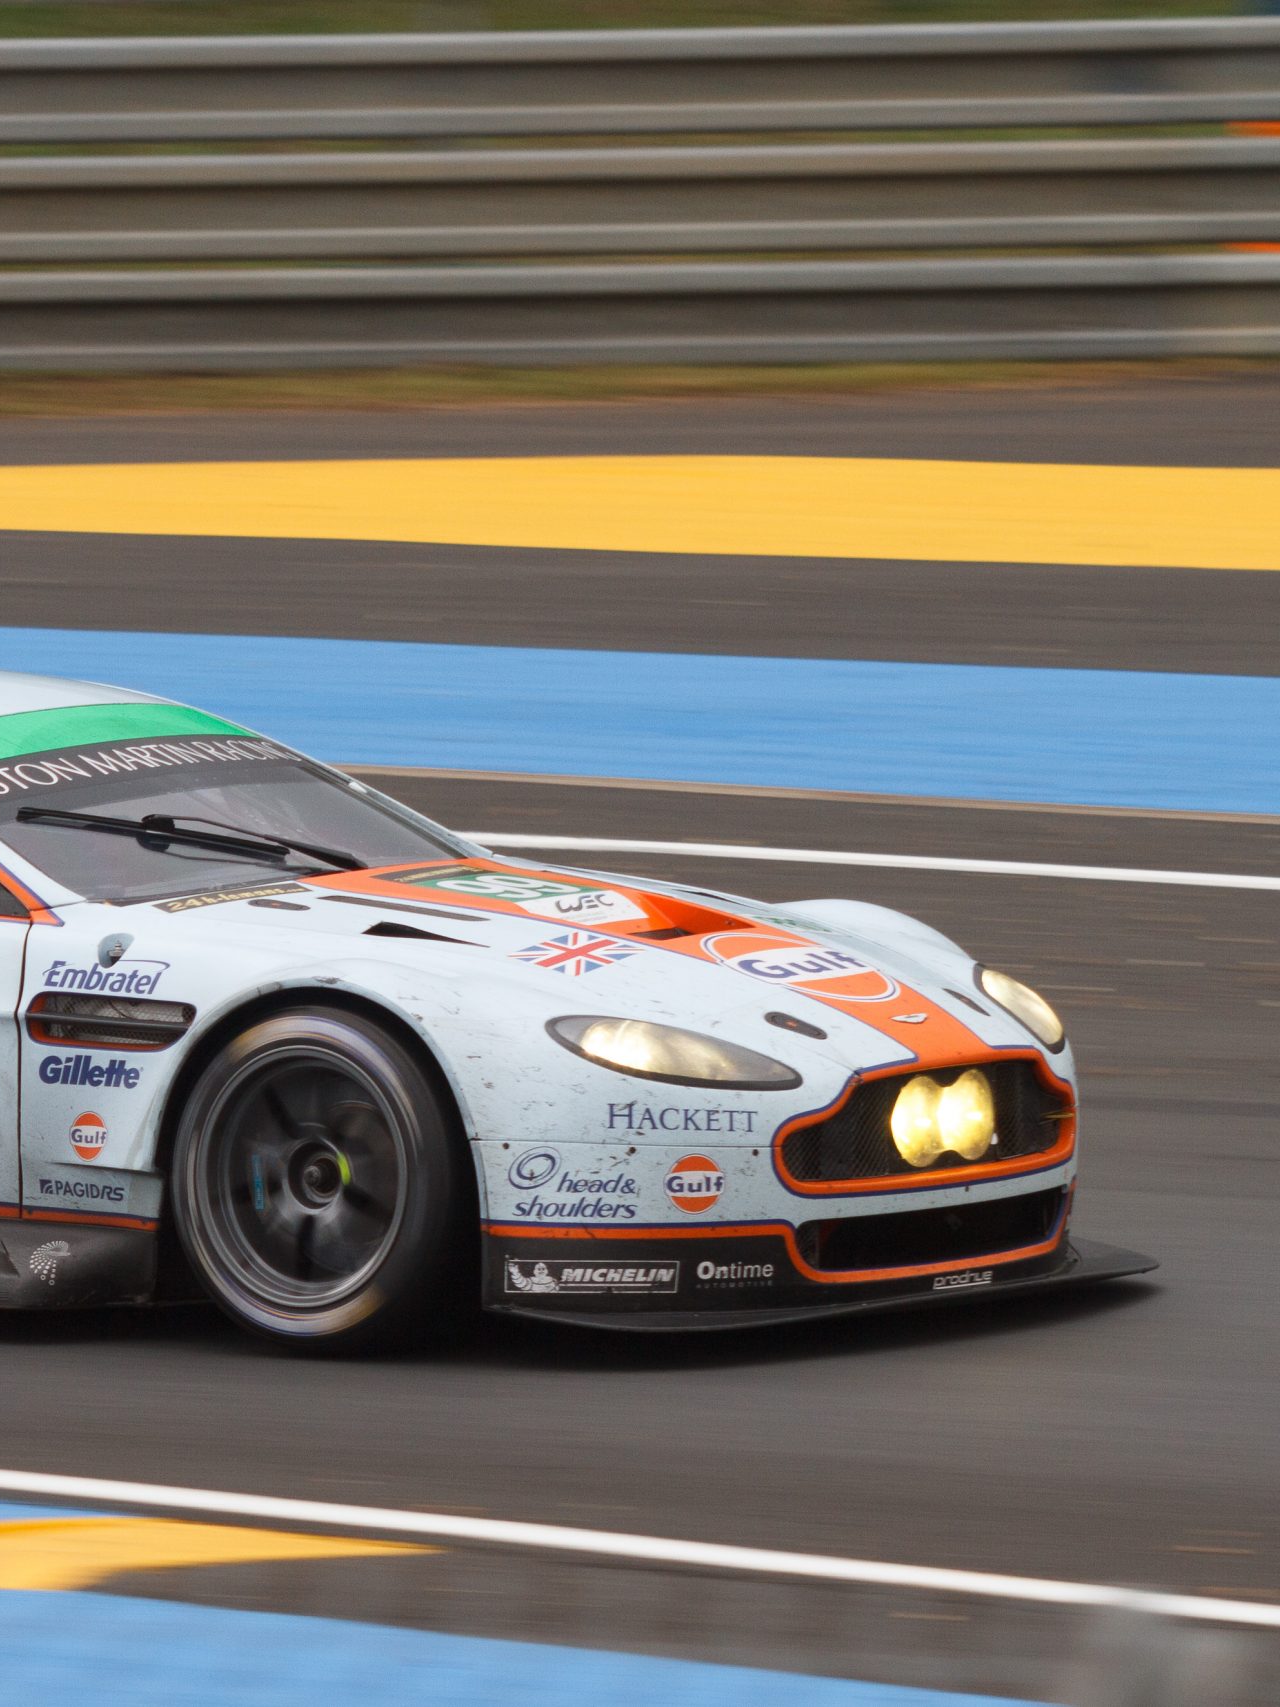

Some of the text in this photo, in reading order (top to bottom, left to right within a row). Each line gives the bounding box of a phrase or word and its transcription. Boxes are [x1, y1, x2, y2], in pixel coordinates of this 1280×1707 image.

[78, 742, 214, 775] MARTIN
[555, 893, 614, 913] WEC
[738, 951, 868, 979] Gulf
[43, 961, 162, 995] Embratel
[39, 1055, 140, 1089] Gillette
[607, 1103, 757, 1133] HACKETT
[71, 1128, 107, 1145] Gulf
[666, 1175, 724, 1193] Gulf
[512, 1195, 638, 1218] shoulders
[560, 1268, 675, 1282] MICHELIN
[697, 1261, 774, 1279] Ontime
